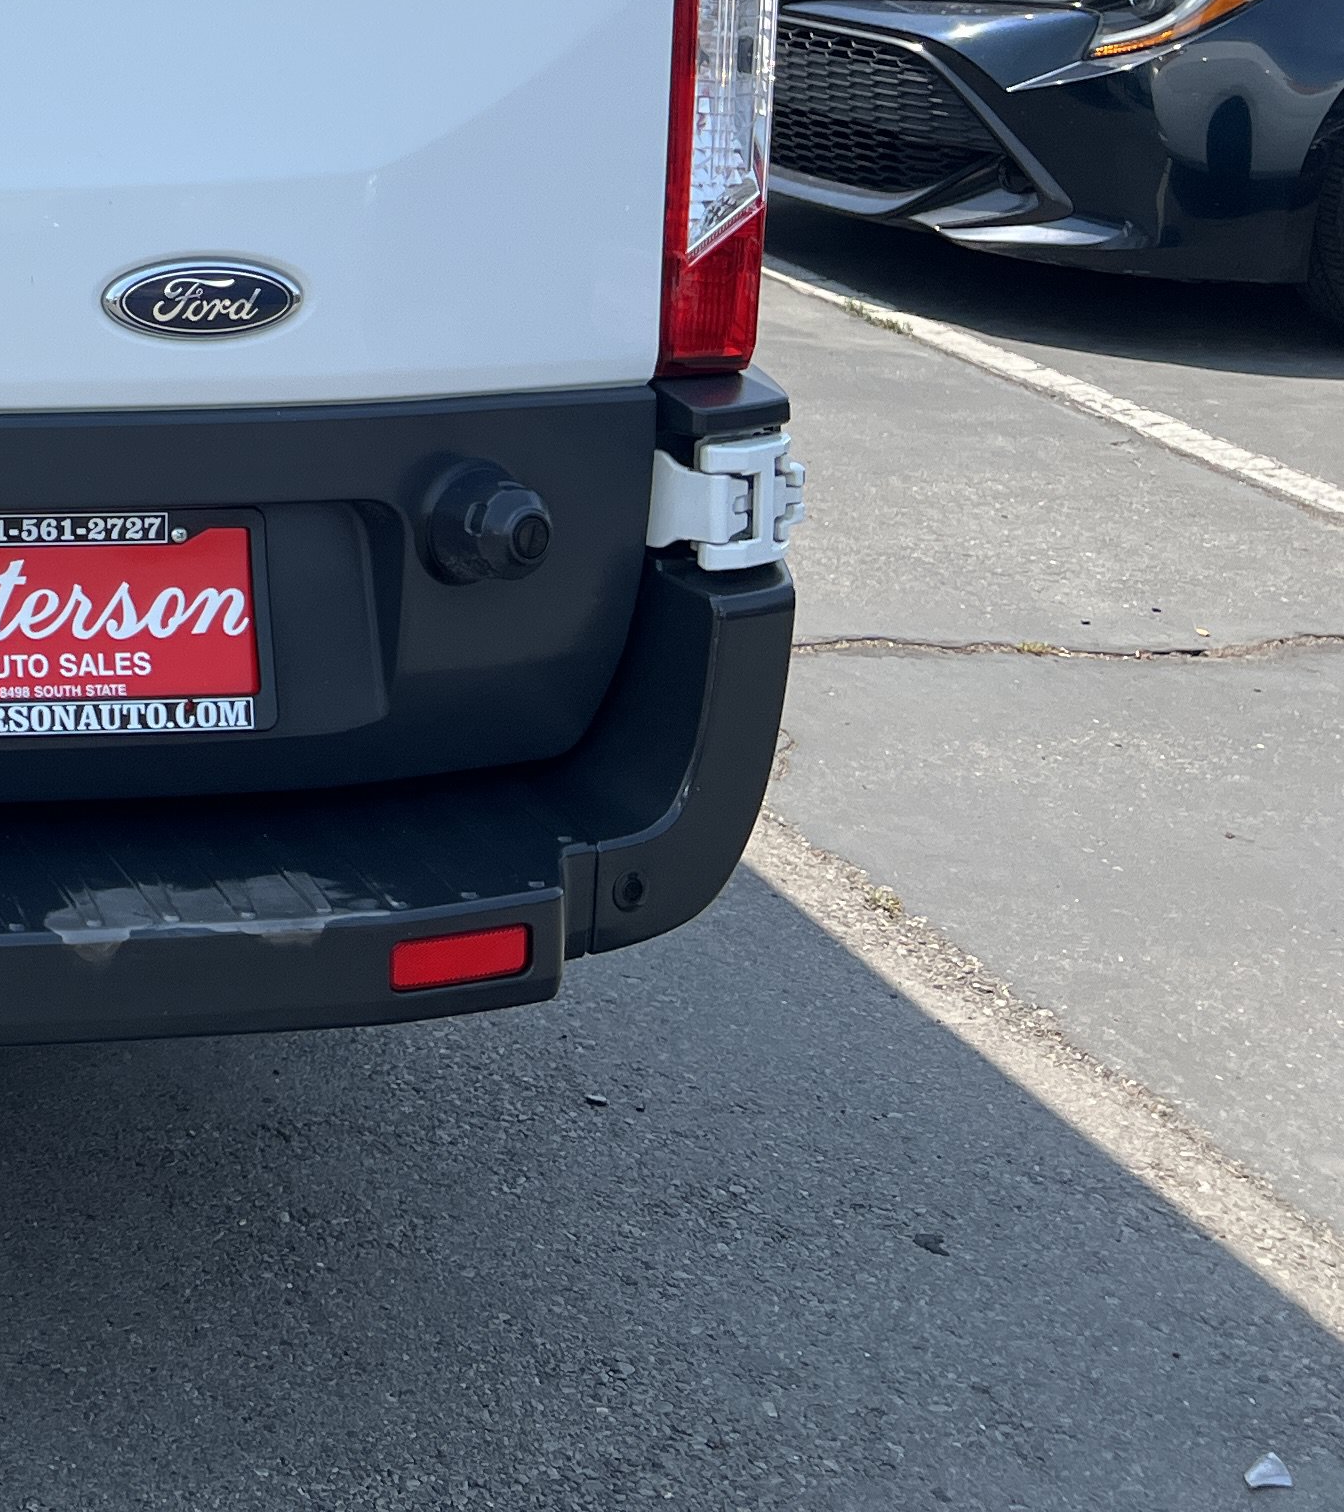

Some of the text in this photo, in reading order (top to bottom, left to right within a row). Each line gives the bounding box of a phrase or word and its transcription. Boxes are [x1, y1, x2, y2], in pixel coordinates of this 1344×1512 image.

[153, 278, 261, 322] Ford
[59, 652, 152, 677] SALES
[0, 683, 127, 699] 8498 SOUTH STATE
